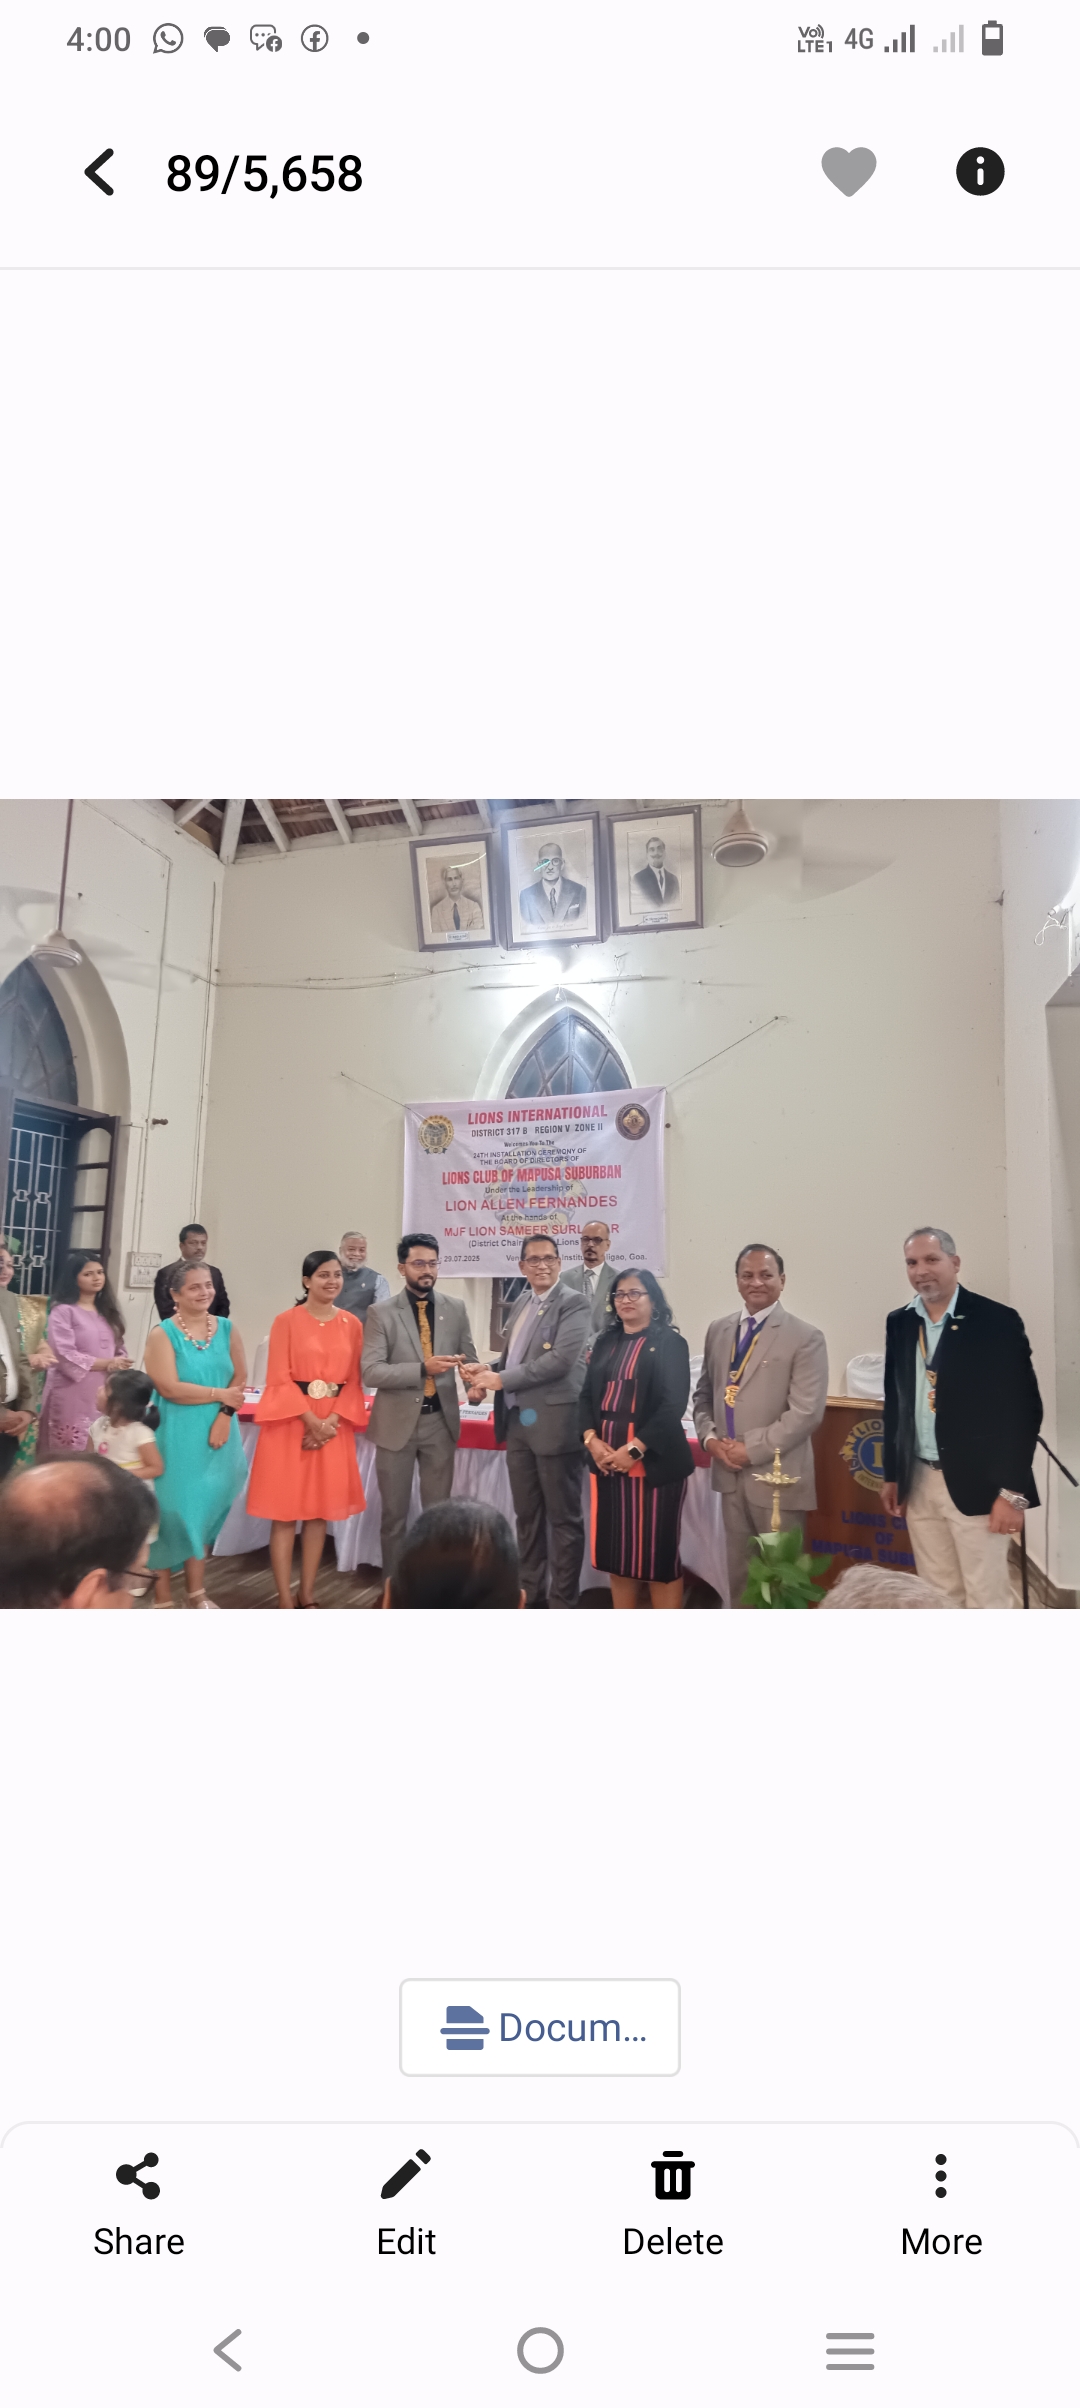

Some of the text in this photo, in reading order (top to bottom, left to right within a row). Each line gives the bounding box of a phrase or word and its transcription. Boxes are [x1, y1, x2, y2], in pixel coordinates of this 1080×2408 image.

[67, 27, 131, 51] 4:00
[844, 27, 874, 50] 4G
[166, 154, 363, 200] 89/5,658
[467, 1111, 504, 1125] LIONS
[507, 1104, 608, 1123] INTERNATIONAL
[471, 1127, 504, 1137] DISTRICT
[506, 1127, 520, 1136] 317
[522, 1126, 528, 1135] B
[534, 1124, 562, 1134] REGION
[564, 1124, 570, 1133] V
[574, 1122, 595, 1132] ZONE
[490, 1150, 537, 1158] INSTALLATION
[539, 1148, 576, 1156] CEREMONY
[529, 1155, 569, 1164] DIRECTORS
[442, 1164, 622, 1185] LIONS CLUB OF MAPUSA SUBURBAN
[485, 1186, 507, 1194] Under
[522, 1184, 564, 1193] Leadership
[445, 1195, 618, 1212] LION ALLEN FERNANDES
[501, 1214, 509, 1222] At
[510, 1213, 523, 1221] the
[524, 1213, 548, 1221] hands
[444, 1226, 466, 1237] MJF
[468, 1226, 497, 1237] LION
[499, 1225, 549, 1236] SAMEER
[468, 1239, 500, 1248] (District
[561, 1253, 584, 1261] Institu
[629, 1253, 648, 1261] Goa.
[874, 1531, 894, 1546] OF
[93, 2226, 185, 2256] Share
[378, 2226, 437, 2256] Edit
[624, 2226, 724, 2256] Delete
[902, 2226, 983, 2256] More
